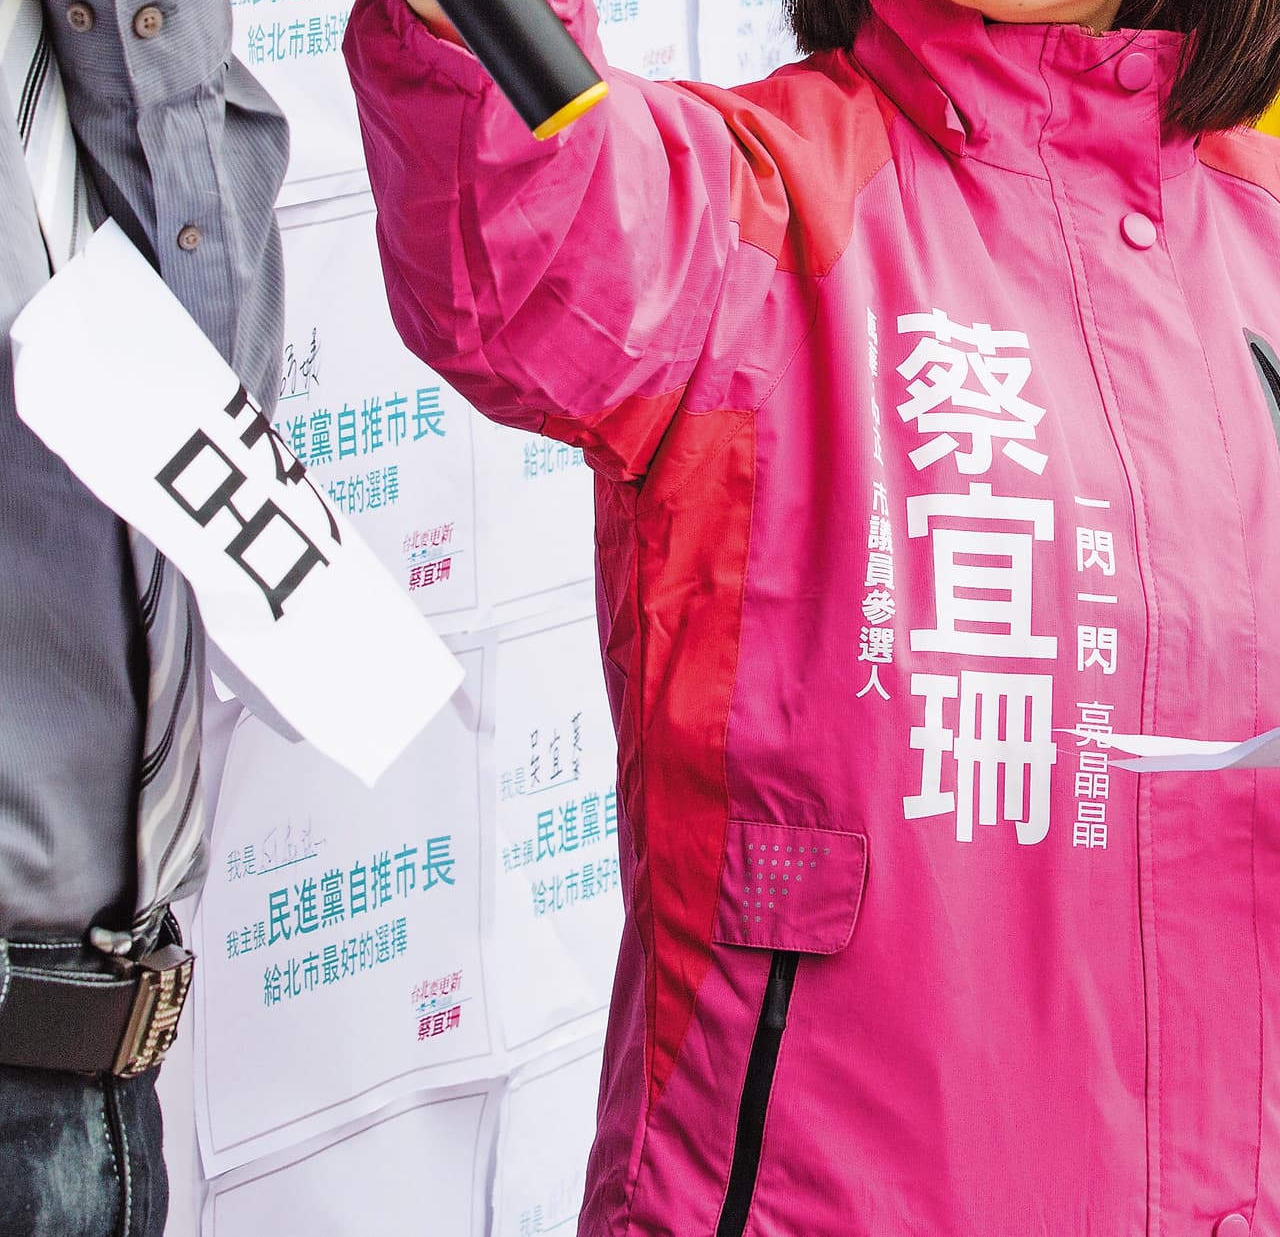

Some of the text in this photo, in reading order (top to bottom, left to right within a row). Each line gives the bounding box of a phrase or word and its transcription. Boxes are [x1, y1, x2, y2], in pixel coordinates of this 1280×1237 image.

[274, 386, 447, 468] 進黨自推市長
[321, 465, 400, 515] 好的選擇
[408, 557, 452, 592] 蔡宜珊
[855, 481, 897, 701] 市議員參選人
[895, 307, 1059, 846] 蔡宜珊
[1072, 495, 1118, 850] 一閃一閃 亮晶晶
[226, 844, 257, 882] 我是
[263, 917, 408, 1007] 給北市最好的選擇
[417, 1005, 461, 1042] 蔡宜珊
